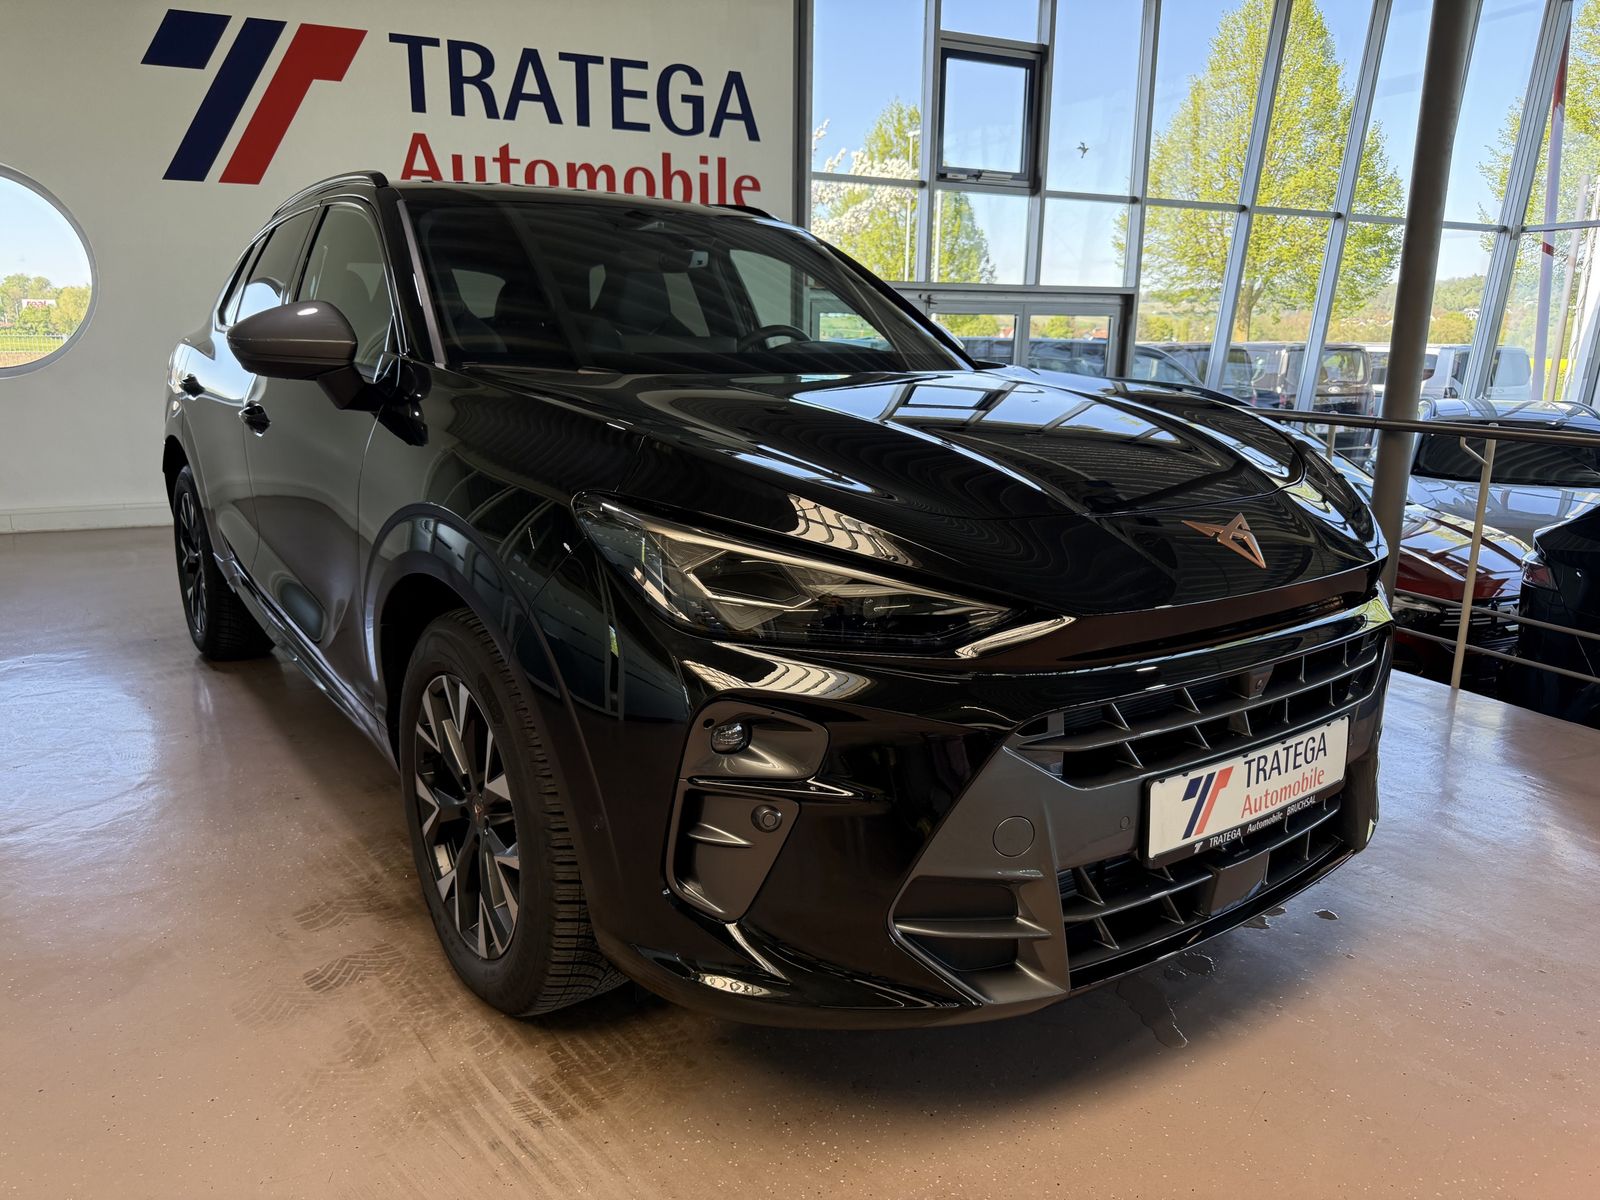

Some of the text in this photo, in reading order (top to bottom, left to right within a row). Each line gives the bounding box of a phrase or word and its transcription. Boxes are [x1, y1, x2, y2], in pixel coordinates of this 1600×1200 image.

[388, 32, 761, 142] TRATEGA
[400, 132, 762, 207] Automobile
[1243, 731, 1328, 789] TRATEGA
[1209, 794, 1317, 848] TRATEGA Automobile BRUCHSAL
[1240, 766, 1325, 819] Automobile
